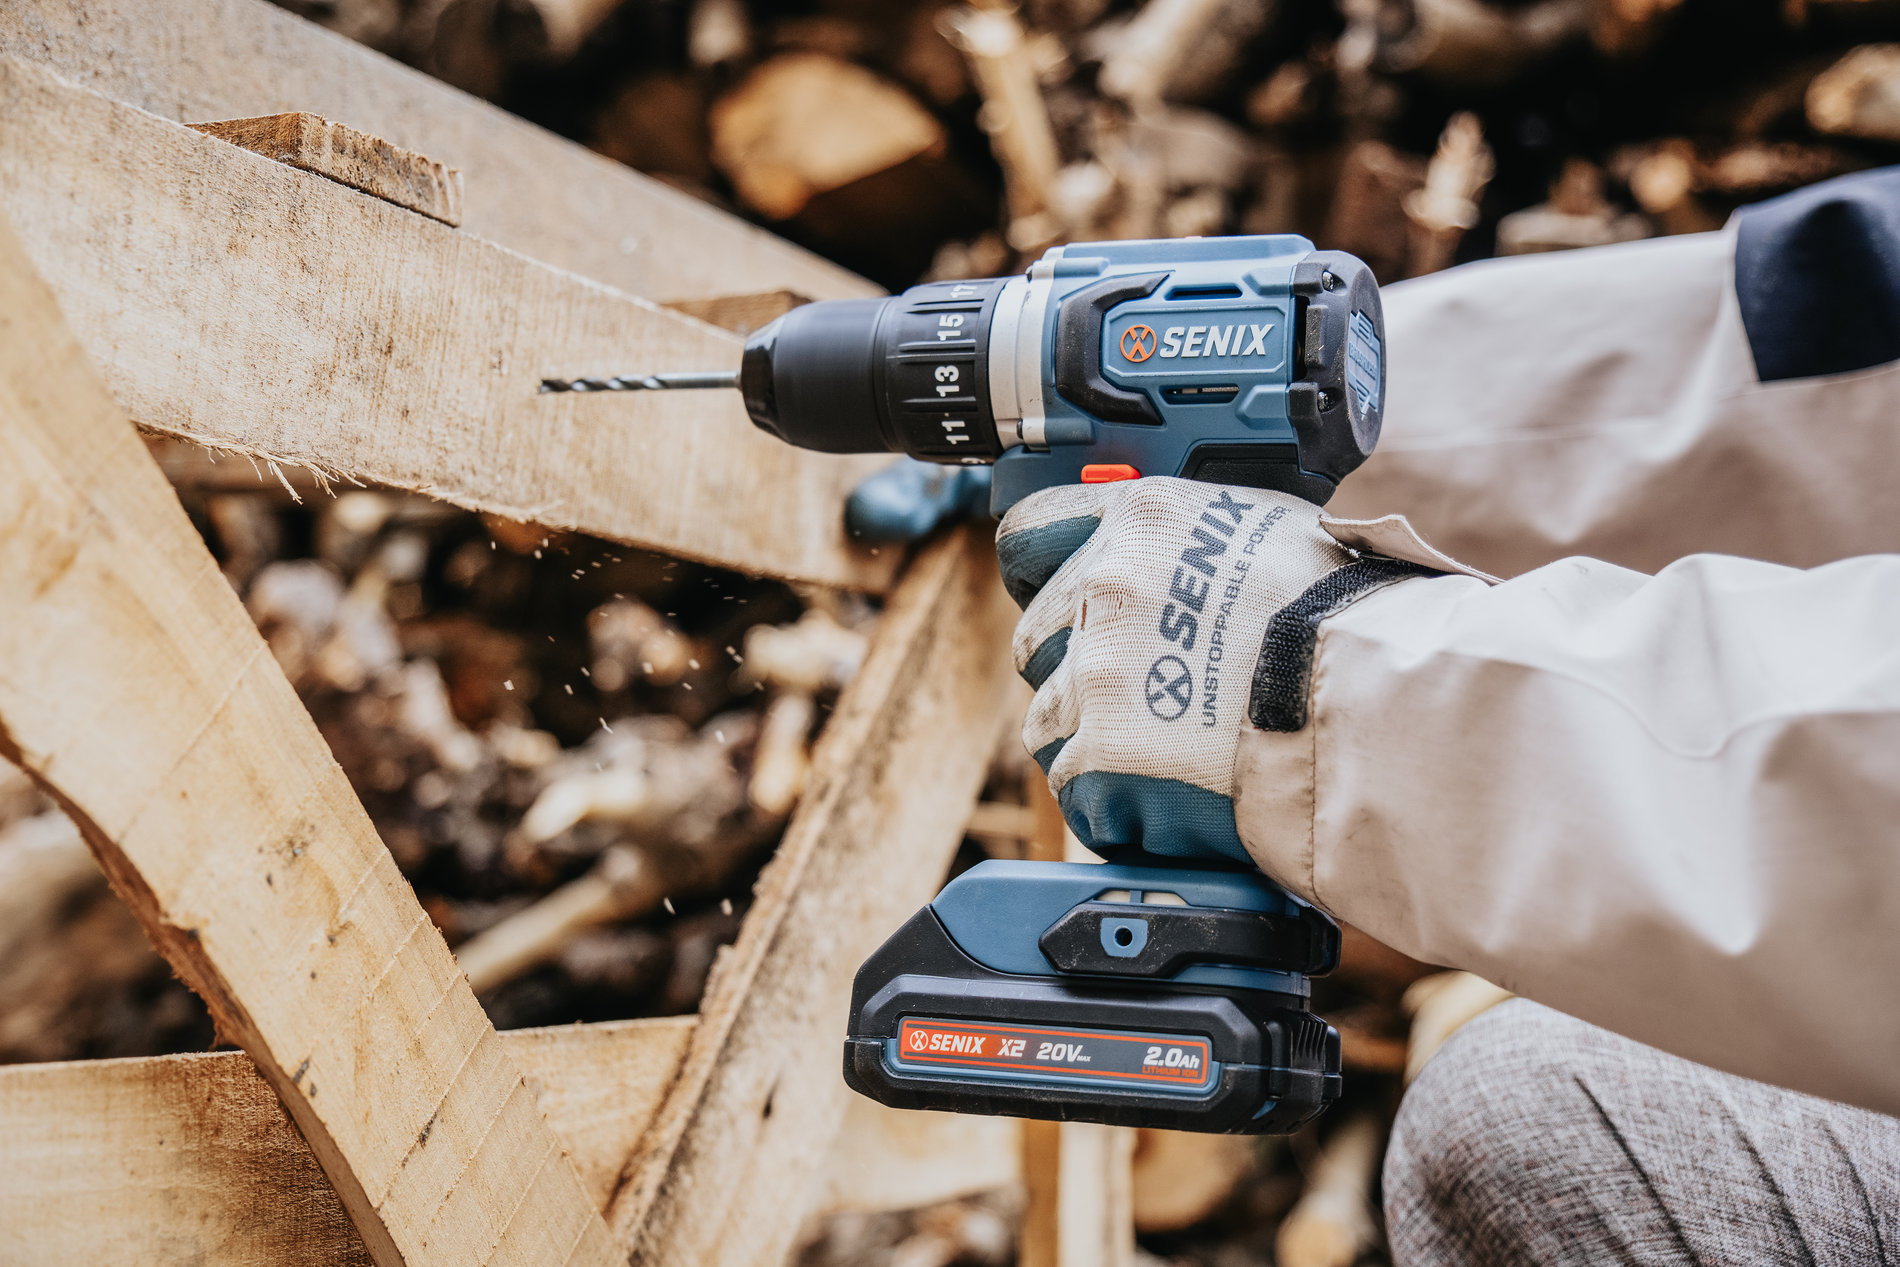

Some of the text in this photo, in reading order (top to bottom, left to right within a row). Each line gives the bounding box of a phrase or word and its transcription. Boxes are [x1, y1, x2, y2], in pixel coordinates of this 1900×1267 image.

[951, 284, 977, 298] 17
[937, 314, 964, 341] 15
[1159, 323, 1276, 359] SENIX
[934, 365, 960, 397] 13
[941, 420, 970, 445] 11
[1159, 490, 1255, 652] SENIX
[1203, 505, 1292, 729] UNSTOPPABLE POWER
[929, 1033, 986, 1054] SENIX
[997, 1038, 1027, 1057] X2
[1143, 1046, 1200, 1069] 2.0Ah
[1142, 1065, 1181, 1077] LITHIUM
